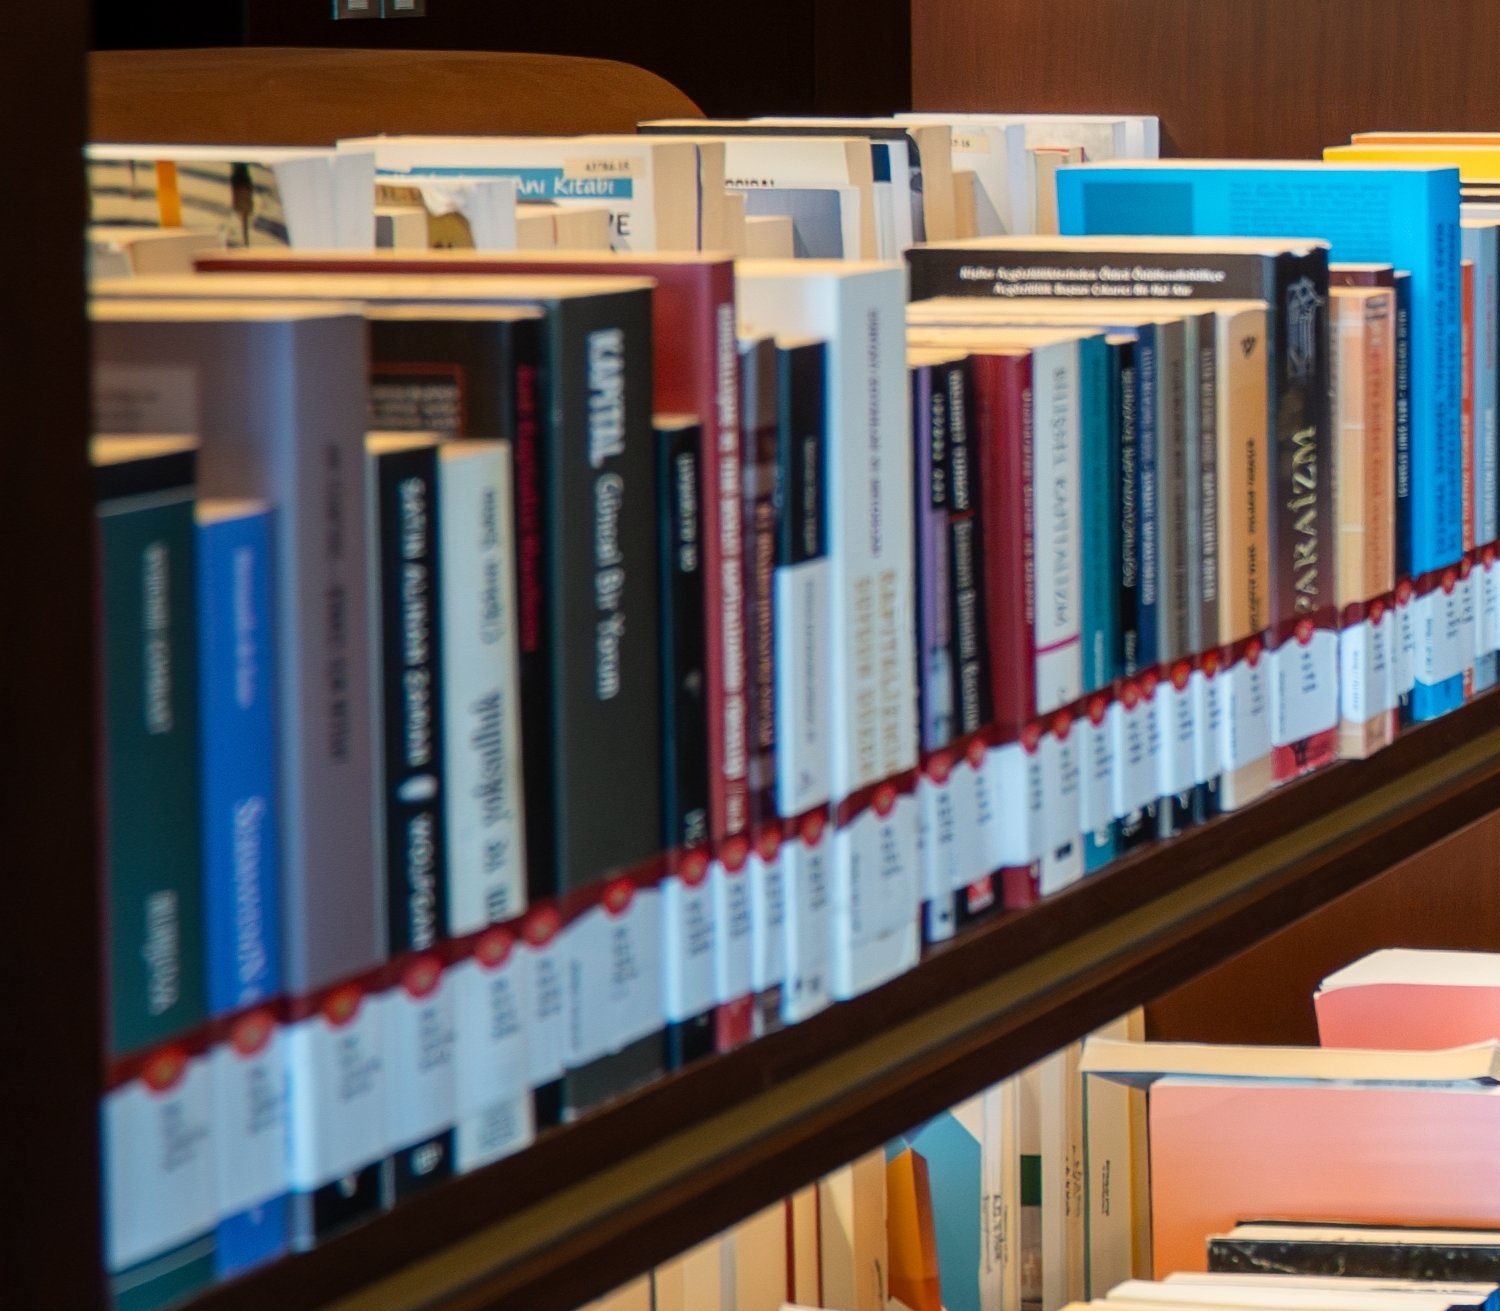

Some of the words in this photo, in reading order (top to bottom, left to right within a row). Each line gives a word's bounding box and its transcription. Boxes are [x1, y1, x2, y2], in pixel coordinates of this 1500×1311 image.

[553, 175, 614, 196] Kitabı
[400, 477, 425, 560] SATIN
[594, 473, 624, 566] Güncel
[402, 563, 427, 666] ALINAN
[595, 567, 625, 609] Bir
[594, 610, 626, 701] Yorum
[405, 670, 431, 767] ZAMAN
[408, 819, 435, 952] WOLFGAN
